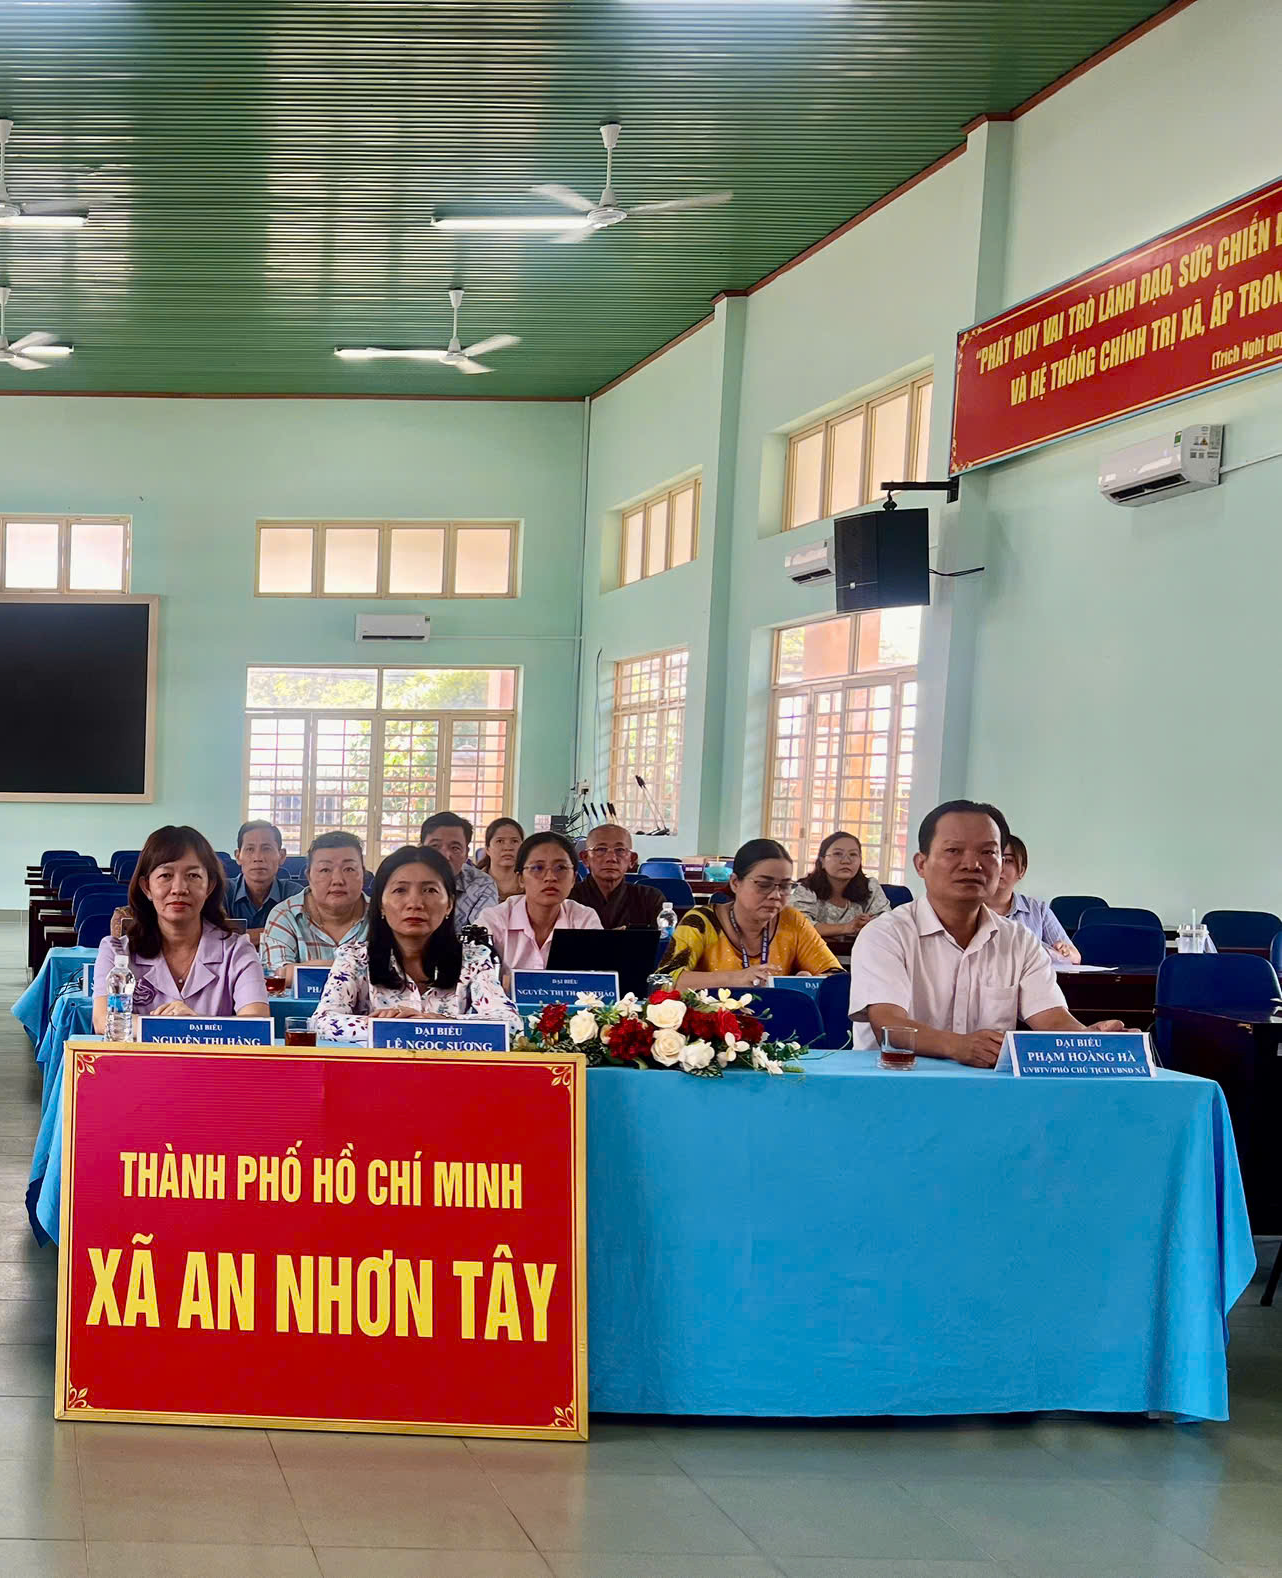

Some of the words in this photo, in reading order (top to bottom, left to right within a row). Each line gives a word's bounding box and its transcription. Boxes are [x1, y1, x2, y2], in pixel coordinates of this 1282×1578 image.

[1014, 322, 1040, 361] HUY
[1043, 315, 1065, 346] VAI
[1068, 294, 1095, 336] TRÒ
[1099, 278, 1136, 323] LÃNH
[1139, 262, 1173, 306] ĐẠO,
[1179, 243, 1213, 288] SỨC
[1217, 211, 1271, 272] CHIẾN
[1010, 367, 1027, 407] VÀ
[1029, 361, 1046, 401] HỆ
[1050, 344, 1096, 391] THỐNG
[1100, 325, 1146, 372] CHÍNH
[1151, 312, 1178, 351] TRỊ
[1180, 297, 1206, 341] XÃ,
[1209, 283, 1234, 329] ẤP
[1242, 335, 1264, 358] Nghị
[415, 1026, 434, 1037] ĐẠI
[437, 1025, 462, 1036] BIỂU
[386, 1037, 403, 1049] LÊ
[446, 1040, 493, 1052] SƯƠNG
[1055, 1038, 1075, 1049] ĐẠI
[1077, 1037, 1102, 1047] BIỂU
[1027, 1051, 1065, 1063] PHẠM
[1068, 1050, 1115, 1062] HOÀNG
[1117, 1050, 1137, 1062] HÀ
[119, 1142, 225, 1200] THÀNH
[238, 1140, 302, 1203] PHỐ
[313, 1142, 355, 1204] HỒ
[367, 1151, 422, 1206] CHÍ
[434, 1161, 523, 1209] MINH
[85, 1232, 160, 1328] XÃ
[177, 1250, 255, 1331] AN
[276, 1249, 433, 1338] NHƠN
[452, 1243, 557, 1342] TÂY
